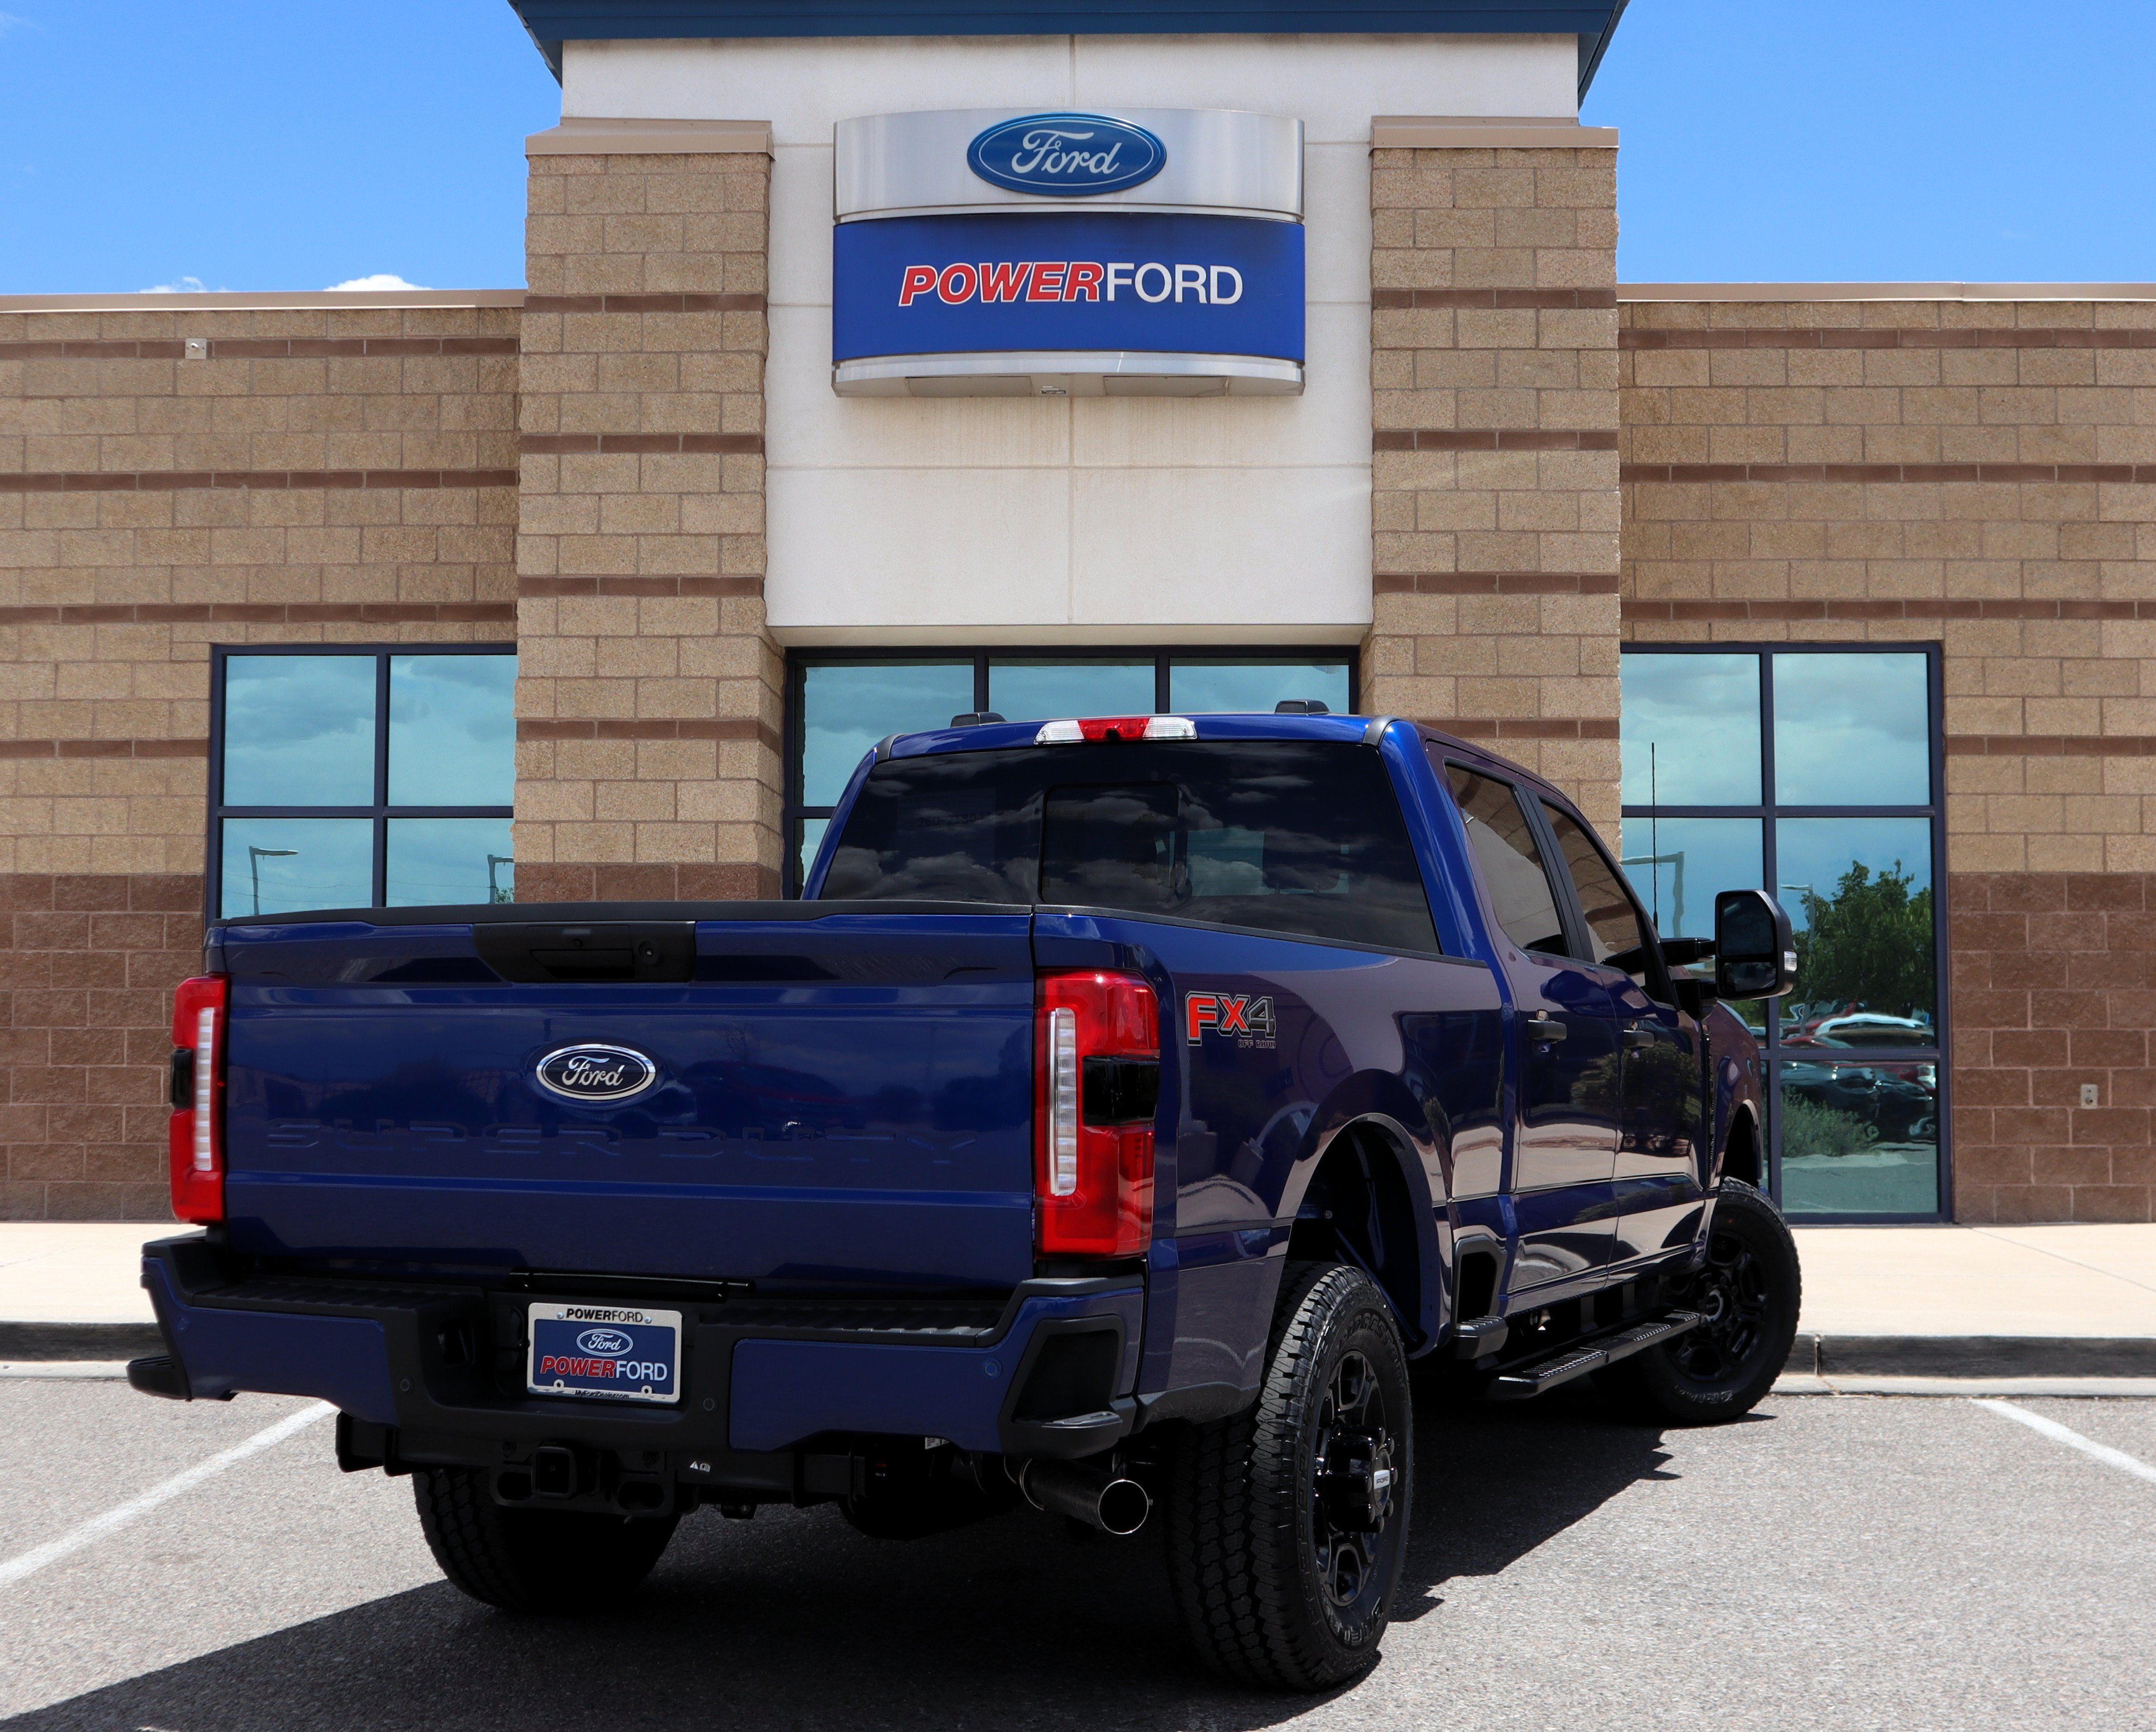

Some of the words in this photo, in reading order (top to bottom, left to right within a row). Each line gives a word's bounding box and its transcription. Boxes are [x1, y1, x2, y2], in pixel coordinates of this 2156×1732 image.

[1011, 129, 1121, 175] Ford
[898, 261, 1243, 307] POWERFORD
[1186, 990, 1276, 1047] FX4
[1237, 1039, 1254, 1048] OFF
[1255, 1040, 1276, 1049] ROAD
[561, 1055, 625, 1086] Ford
[565, 1308, 644, 1323] POWERFORD
[588, 1333, 622, 1351] Ford
[540, 1355, 668, 1382] POWERFORD
